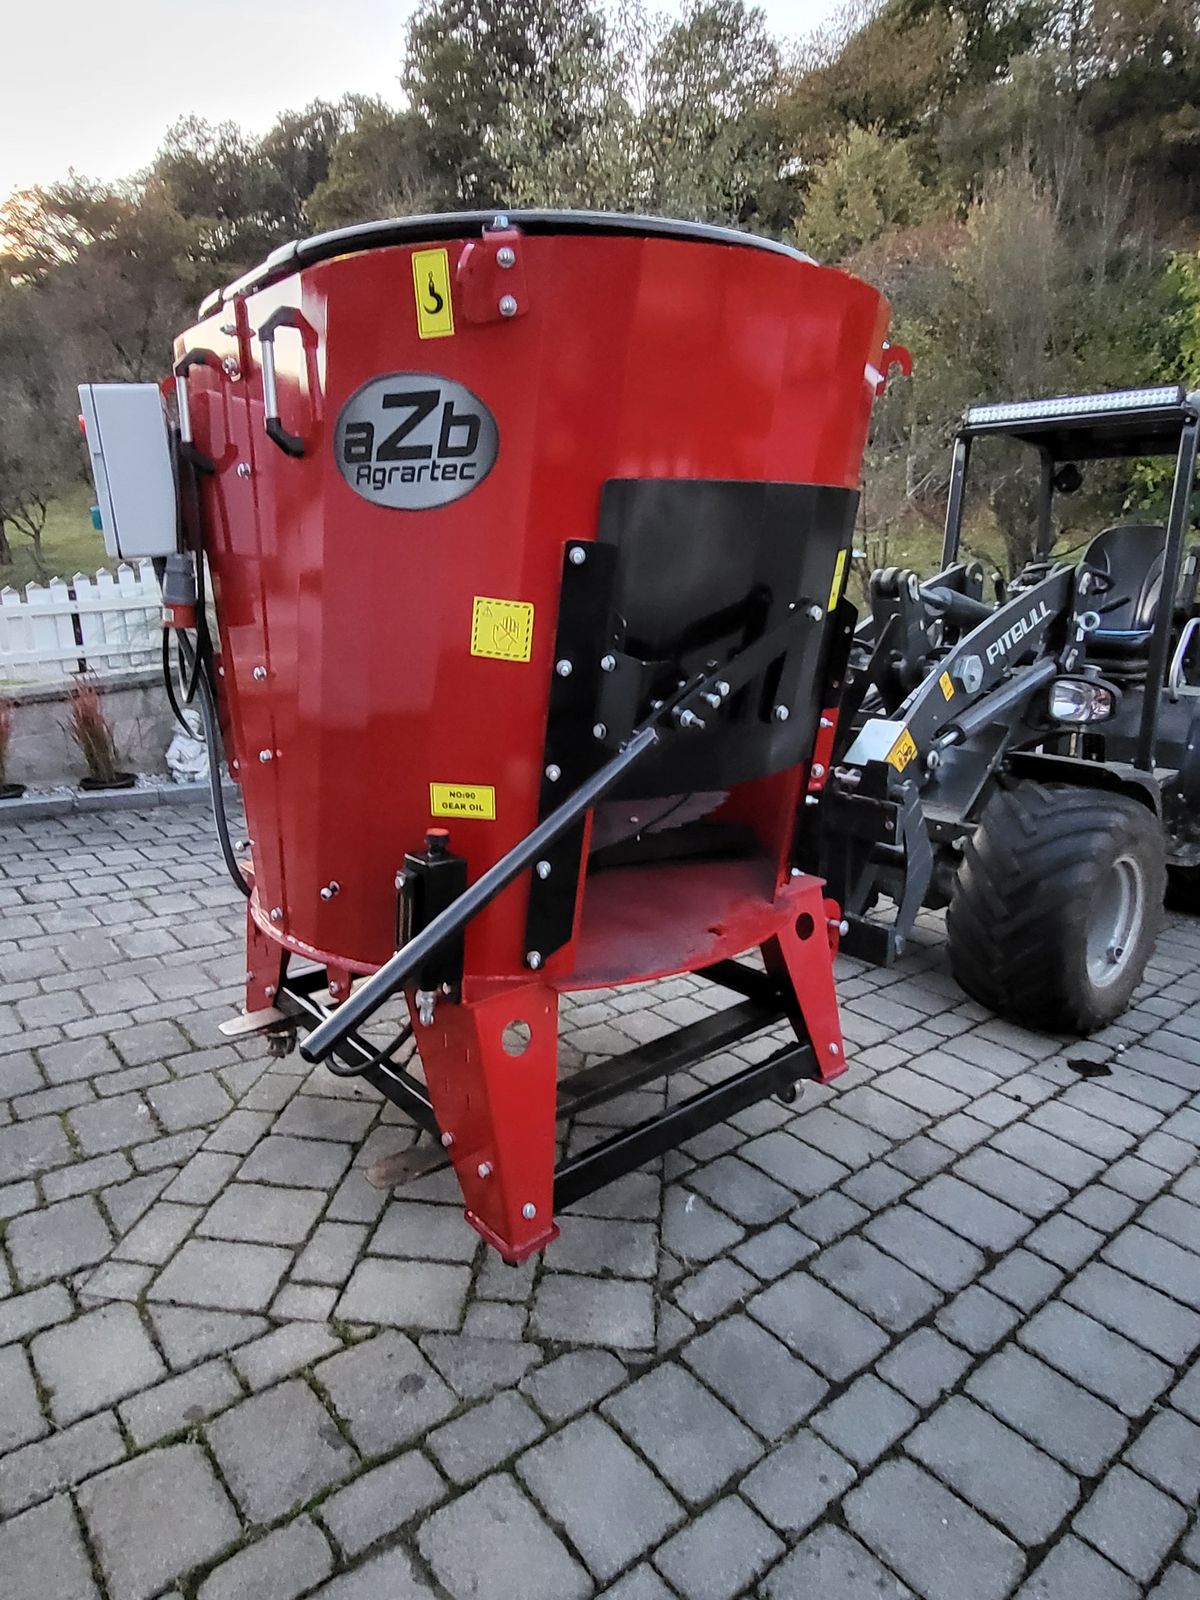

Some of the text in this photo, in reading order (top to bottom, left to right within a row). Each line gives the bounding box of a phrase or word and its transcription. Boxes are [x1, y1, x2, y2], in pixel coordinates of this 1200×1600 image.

[344, 389, 481, 463] aZb
[356, 460, 477, 490] Agrartec
[985, 601, 1052, 665] PITBULL
[442, 802, 484, 811] GEAR OIL
